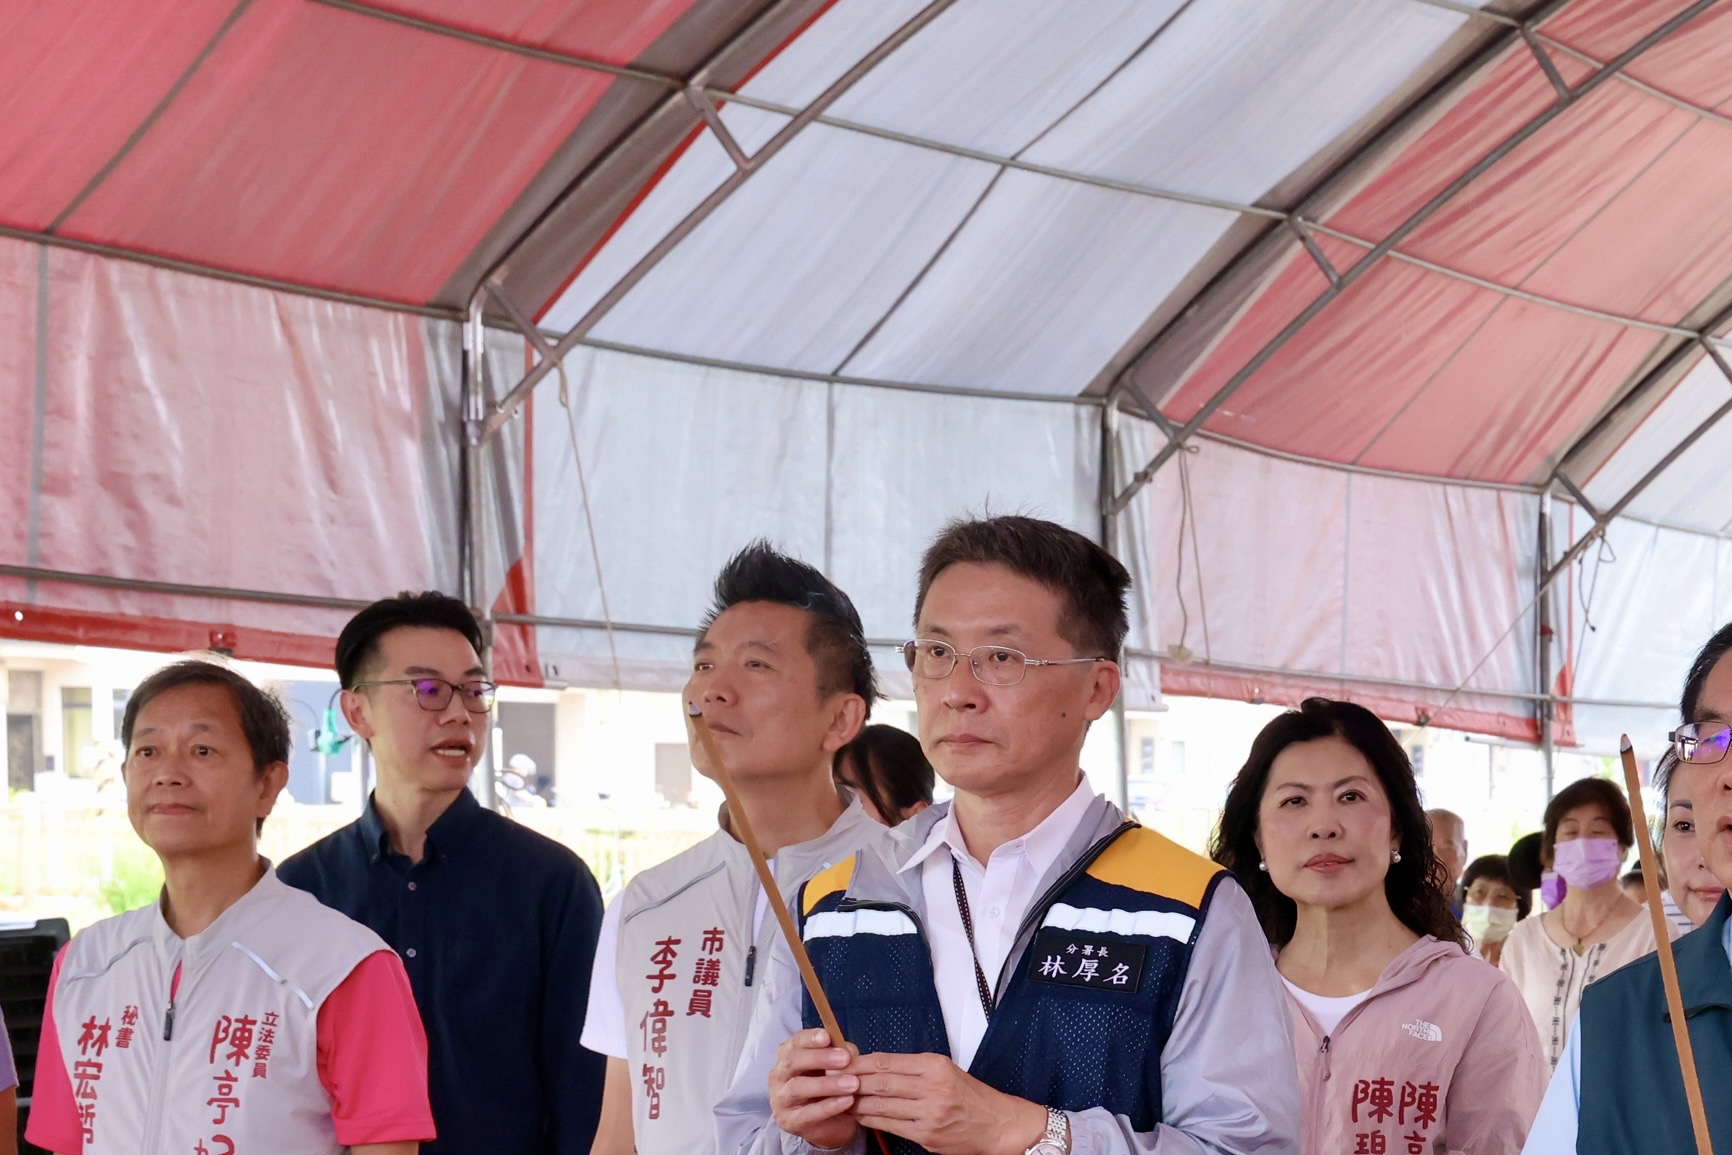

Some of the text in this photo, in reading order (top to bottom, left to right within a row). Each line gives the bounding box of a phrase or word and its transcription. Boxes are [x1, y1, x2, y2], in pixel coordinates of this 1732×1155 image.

[1065, 943, 1109, 958] 分署長
[686, 927, 725, 1018] 市議員
[1038, 955, 1130, 985] 林厚名
[115, 1005, 139, 1049] 秘書
[639, 936, 682, 1120] 李偉智
[1401, 1023, 1431, 1035] NORTH
[1408, 1031, 1430, 1041] FACE
[1416, 1019, 1431, 1029] THE
[252, 1011, 279, 1078] 立法委員
